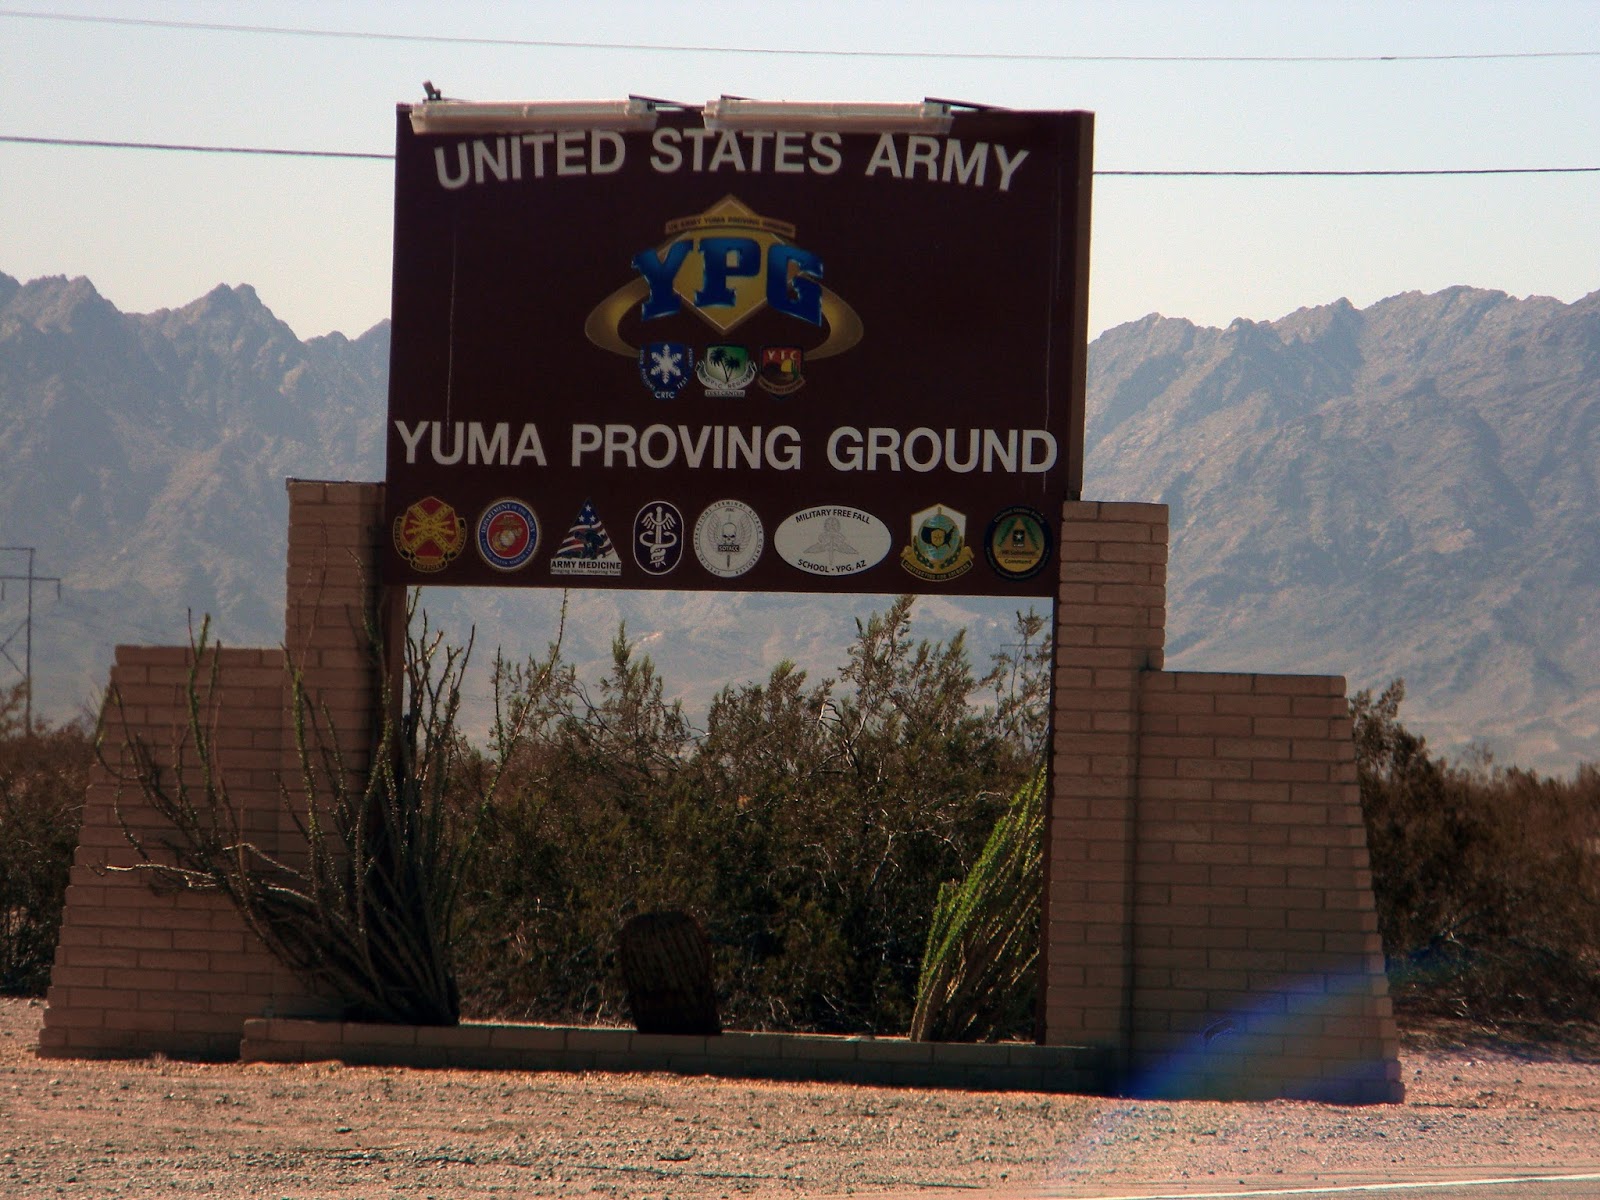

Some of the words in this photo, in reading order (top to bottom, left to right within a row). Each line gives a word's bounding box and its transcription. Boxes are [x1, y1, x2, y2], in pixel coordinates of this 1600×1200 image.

[433, 129, 627, 191] UNITED
[649, 127, 844, 176] STATES
[864, 132, 1031, 193] ARMY
[631, 237, 825, 328] YPG
[393, 420, 548, 467] YUMA
[571, 423, 802, 471] PROVING
[826, 426, 1059, 474] GROUND
[713, 500, 747, 510] TERMINAL
[795, 508, 832, 523] MILITARY
[832, 508, 852, 518] FREE
[852, 512, 870, 525] FALL
[480, 503, 511, 533] DEPARTMENT
[551, 560, 577, 569] ARMY
[578, 561, 622, 570] MEDICINE
[798, 559, 830, 573] SCHOOL
[855, 559, 867, 569] AZ
